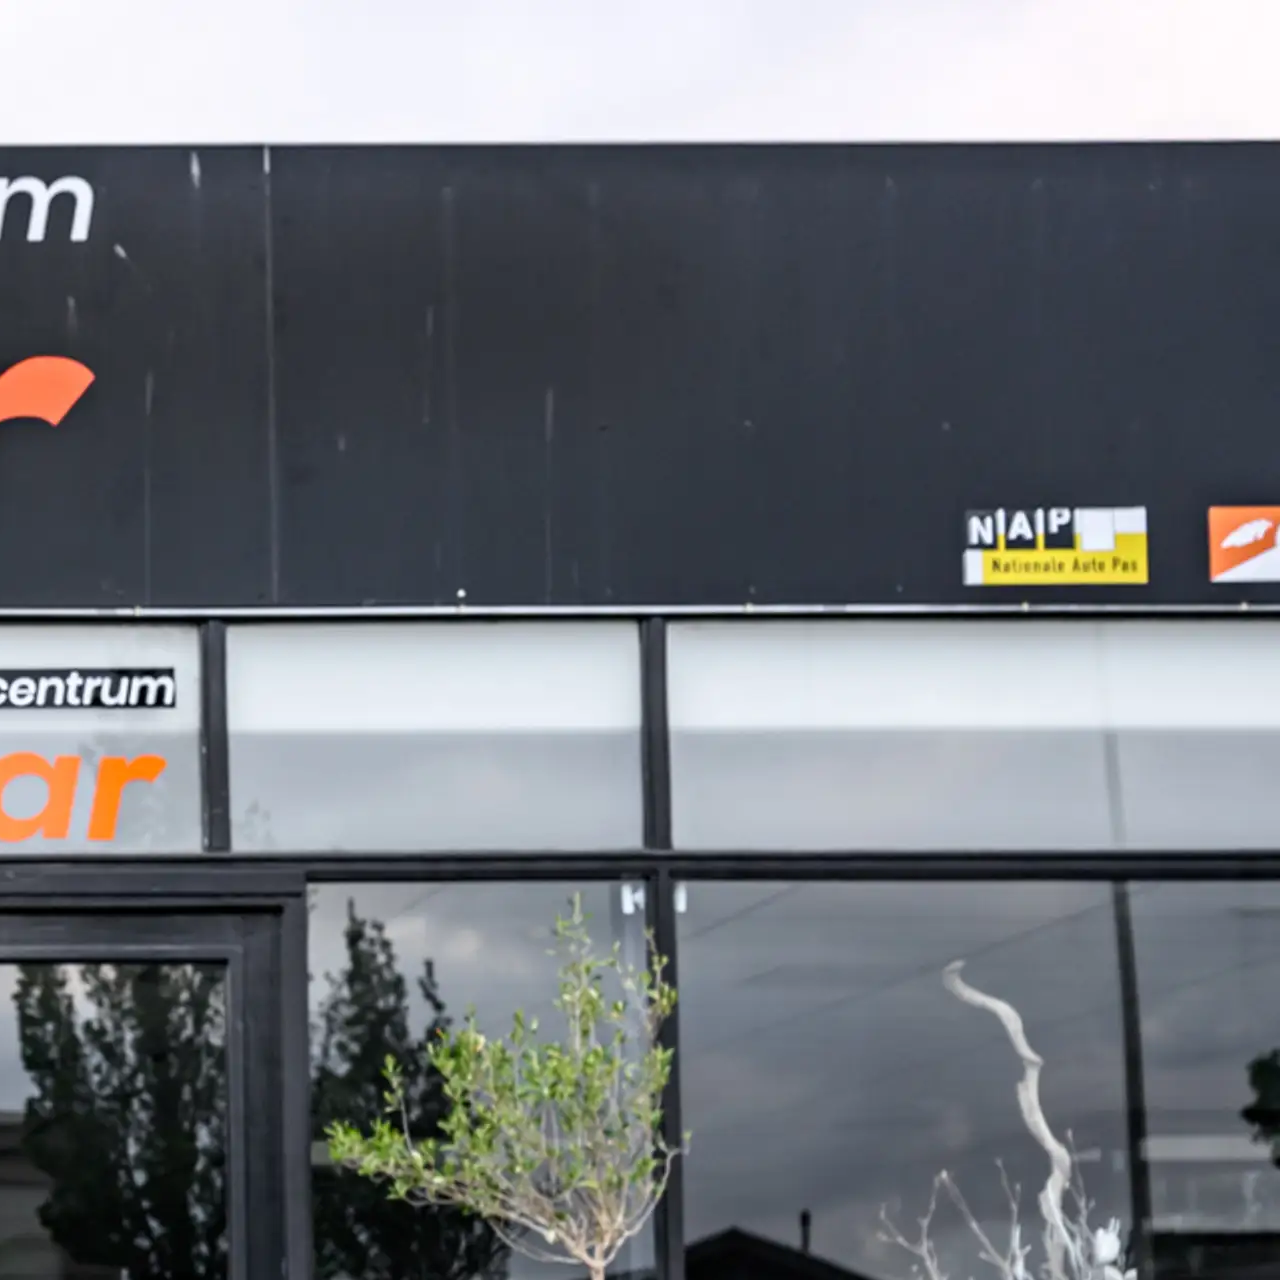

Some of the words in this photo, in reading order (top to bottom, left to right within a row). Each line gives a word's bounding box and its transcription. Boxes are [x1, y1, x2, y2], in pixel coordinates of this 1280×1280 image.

[991, 558, 1066, 573] Nationale
[1072, 558, 1106, 572] Auto
[1111, 557, 1138, 572] Pas
